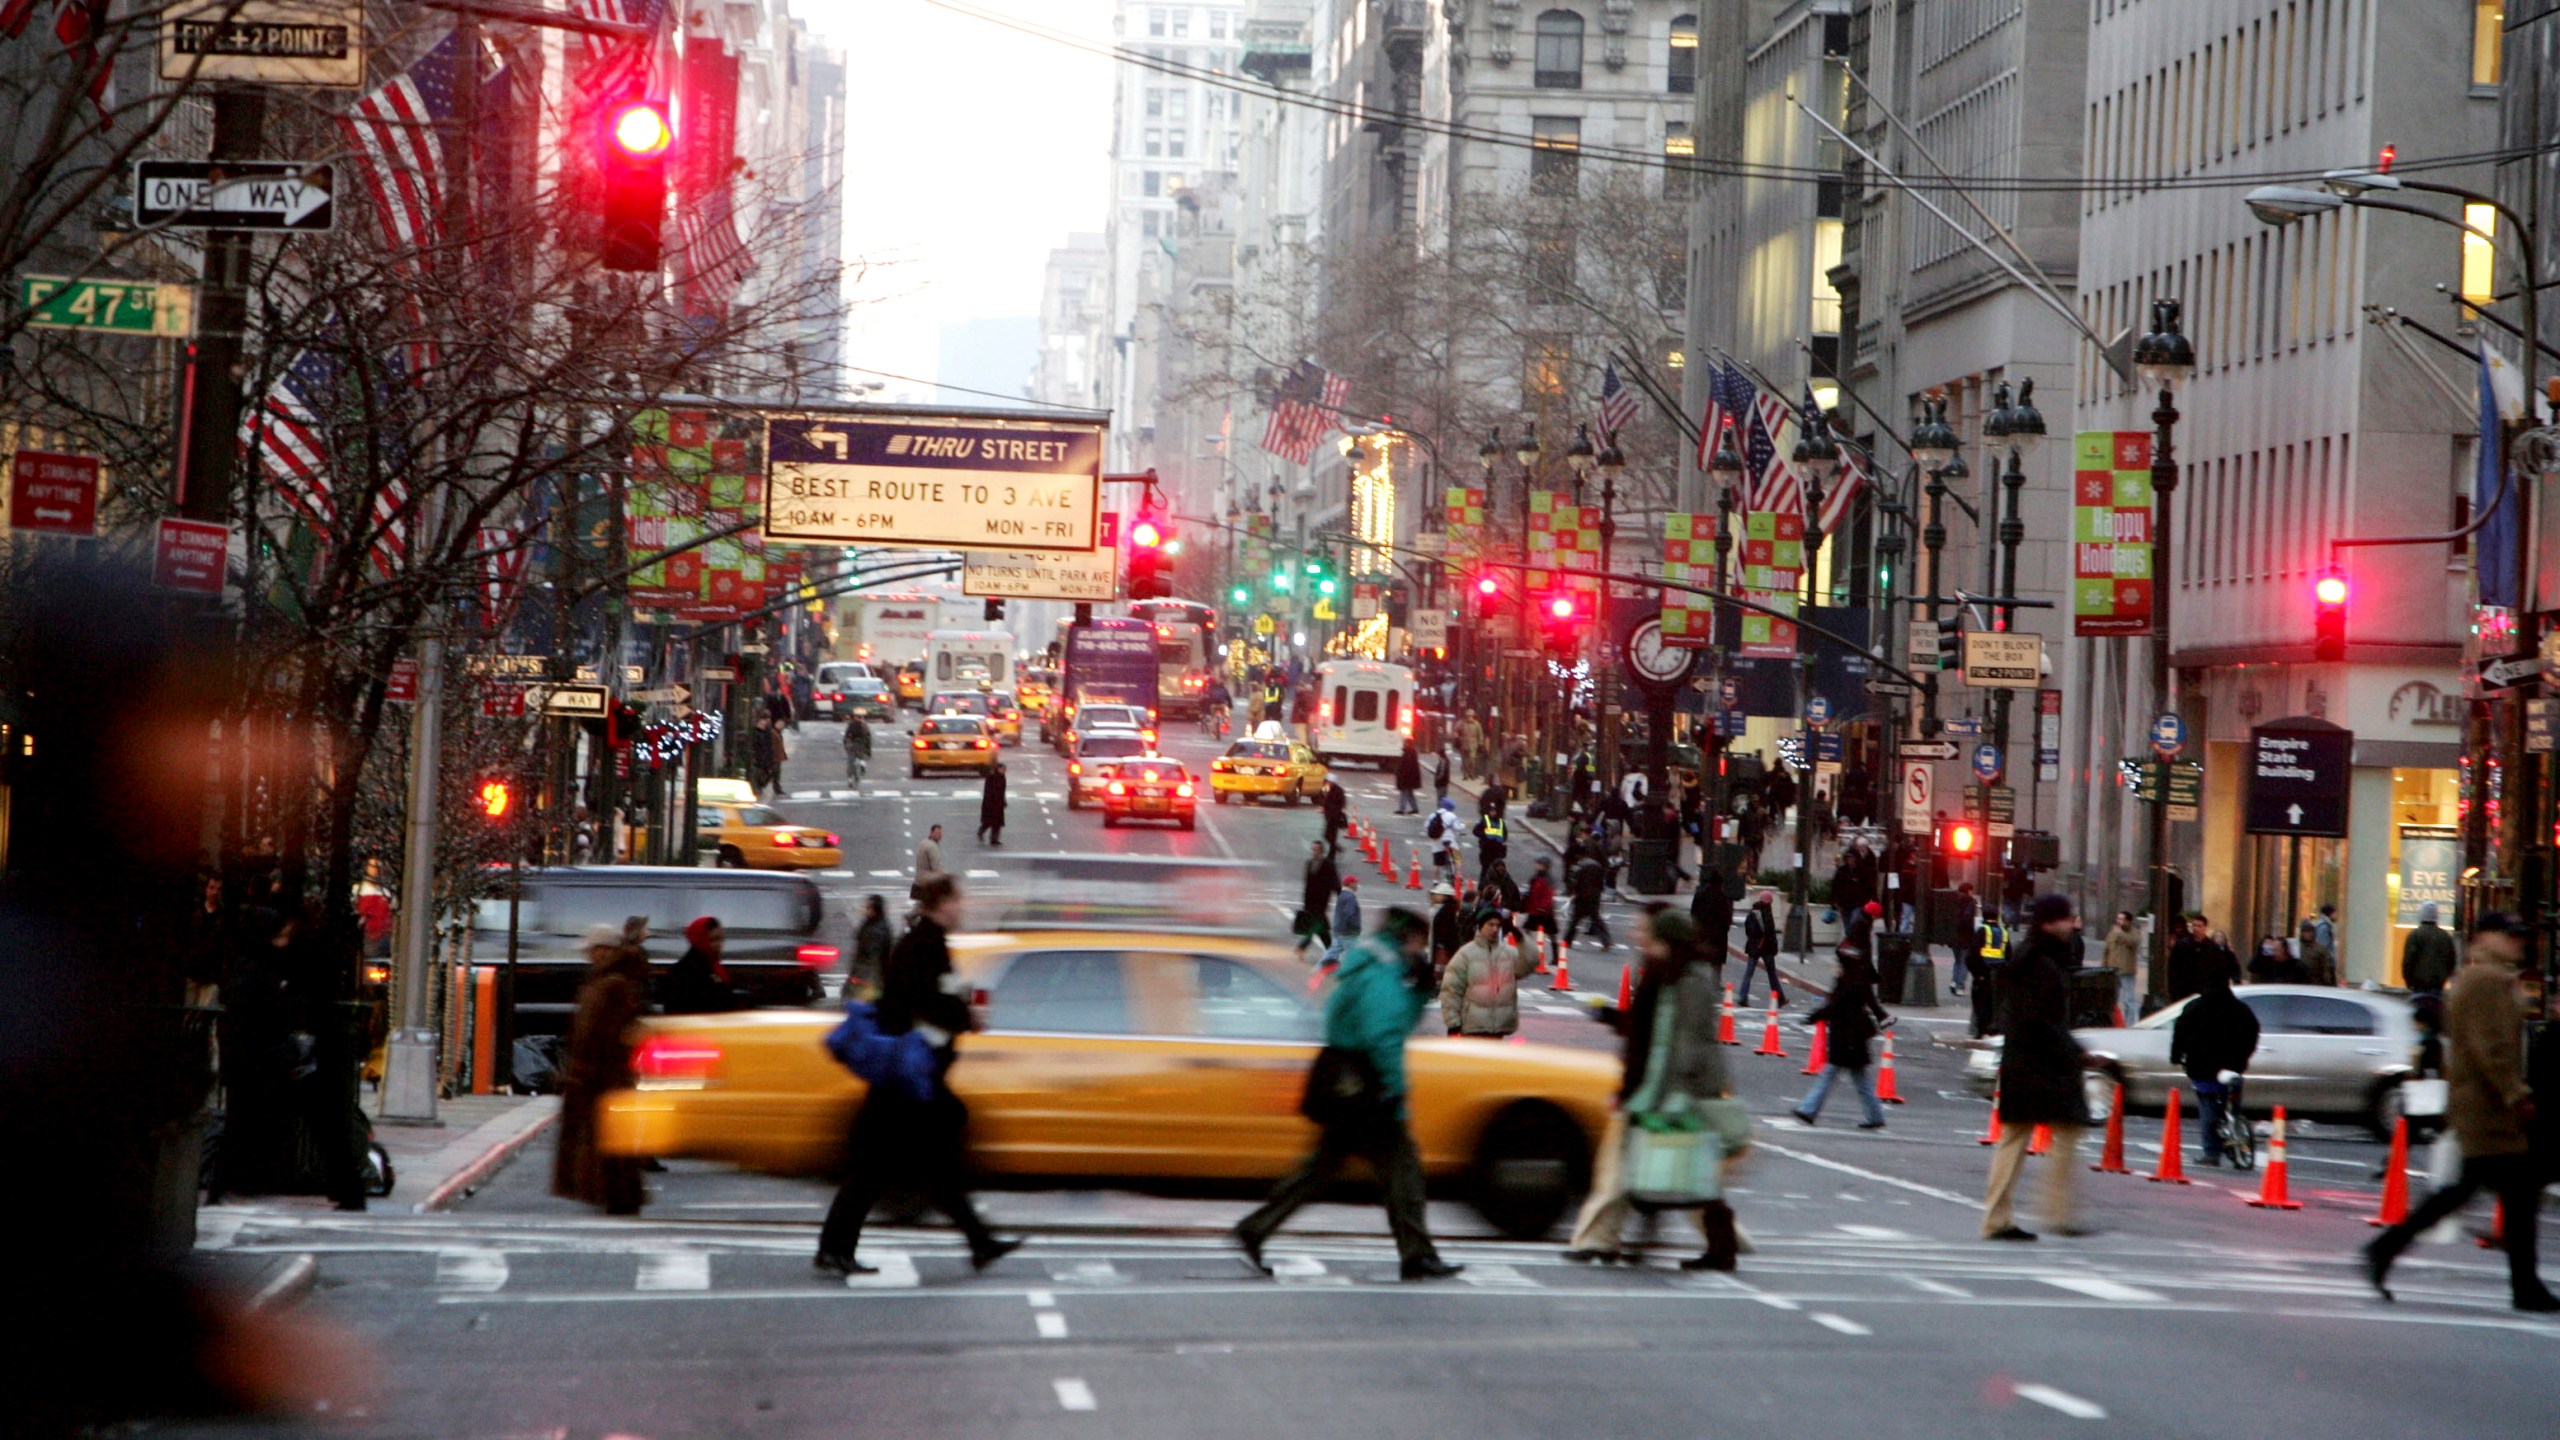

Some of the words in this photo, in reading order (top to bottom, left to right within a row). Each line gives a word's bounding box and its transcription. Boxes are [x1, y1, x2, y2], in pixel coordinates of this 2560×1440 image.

[155, 182, 209, 207] ONE
[249, 184, 306, 208] WAY
[28, 282, 53, 321] E
[68, 286, 125, 325] 47
[911, 435, 975, 458] THRU
[981, 439, 1068, 462] STREET
[19, 462, 34, 477] NO
[40, 464, 93, 483] STANDING
[27, 483, 83, 503] ANYTIME
[792, 477, 850, 498] BEST
[868, 480, 944, 503] ROUTE
[961, 485, 988, 504] TO
[1004, 487, 1017, 505] 3
[1028, 488, 1072, 508] AVE
[789, 510, 835, 526] 10AM
[856, 513, 895, 529] 6PM
[2093, 507, 2144, 542] Happy
[163, 529, 176, 542] NO
[986, 518, 1024, 535] MON
[1044, 521, 1074, 538] FRI
[169, 550, 214, 566] ANYTIME
[2080, 543, 2145, 576] Holidays
[968, 565, 983, 576] NO
[987, 566, 1022, 579] TURNS
[1026, 568, 1056, 581] UNTIL
[1060, 570, 1087, 582] PARK
[1092, 571, 1111, 584] AVE
[1421, 615, 1438, 626] NO
[2003, 641, 2034, 650] BLOCK
[1983, 651, 2001, 660] THE
[2494, 664, 2524, 680] ONE
[568, 694, 594, 706] WAY
[2259, 737, 2309, 750] Empire
[2258, 752, 2297, 764] State
[2257, 766, 2315, 781] Building
[2412, 871, 2447, 887] EYE
[2401, 888, 2456, 902] EXAMS
